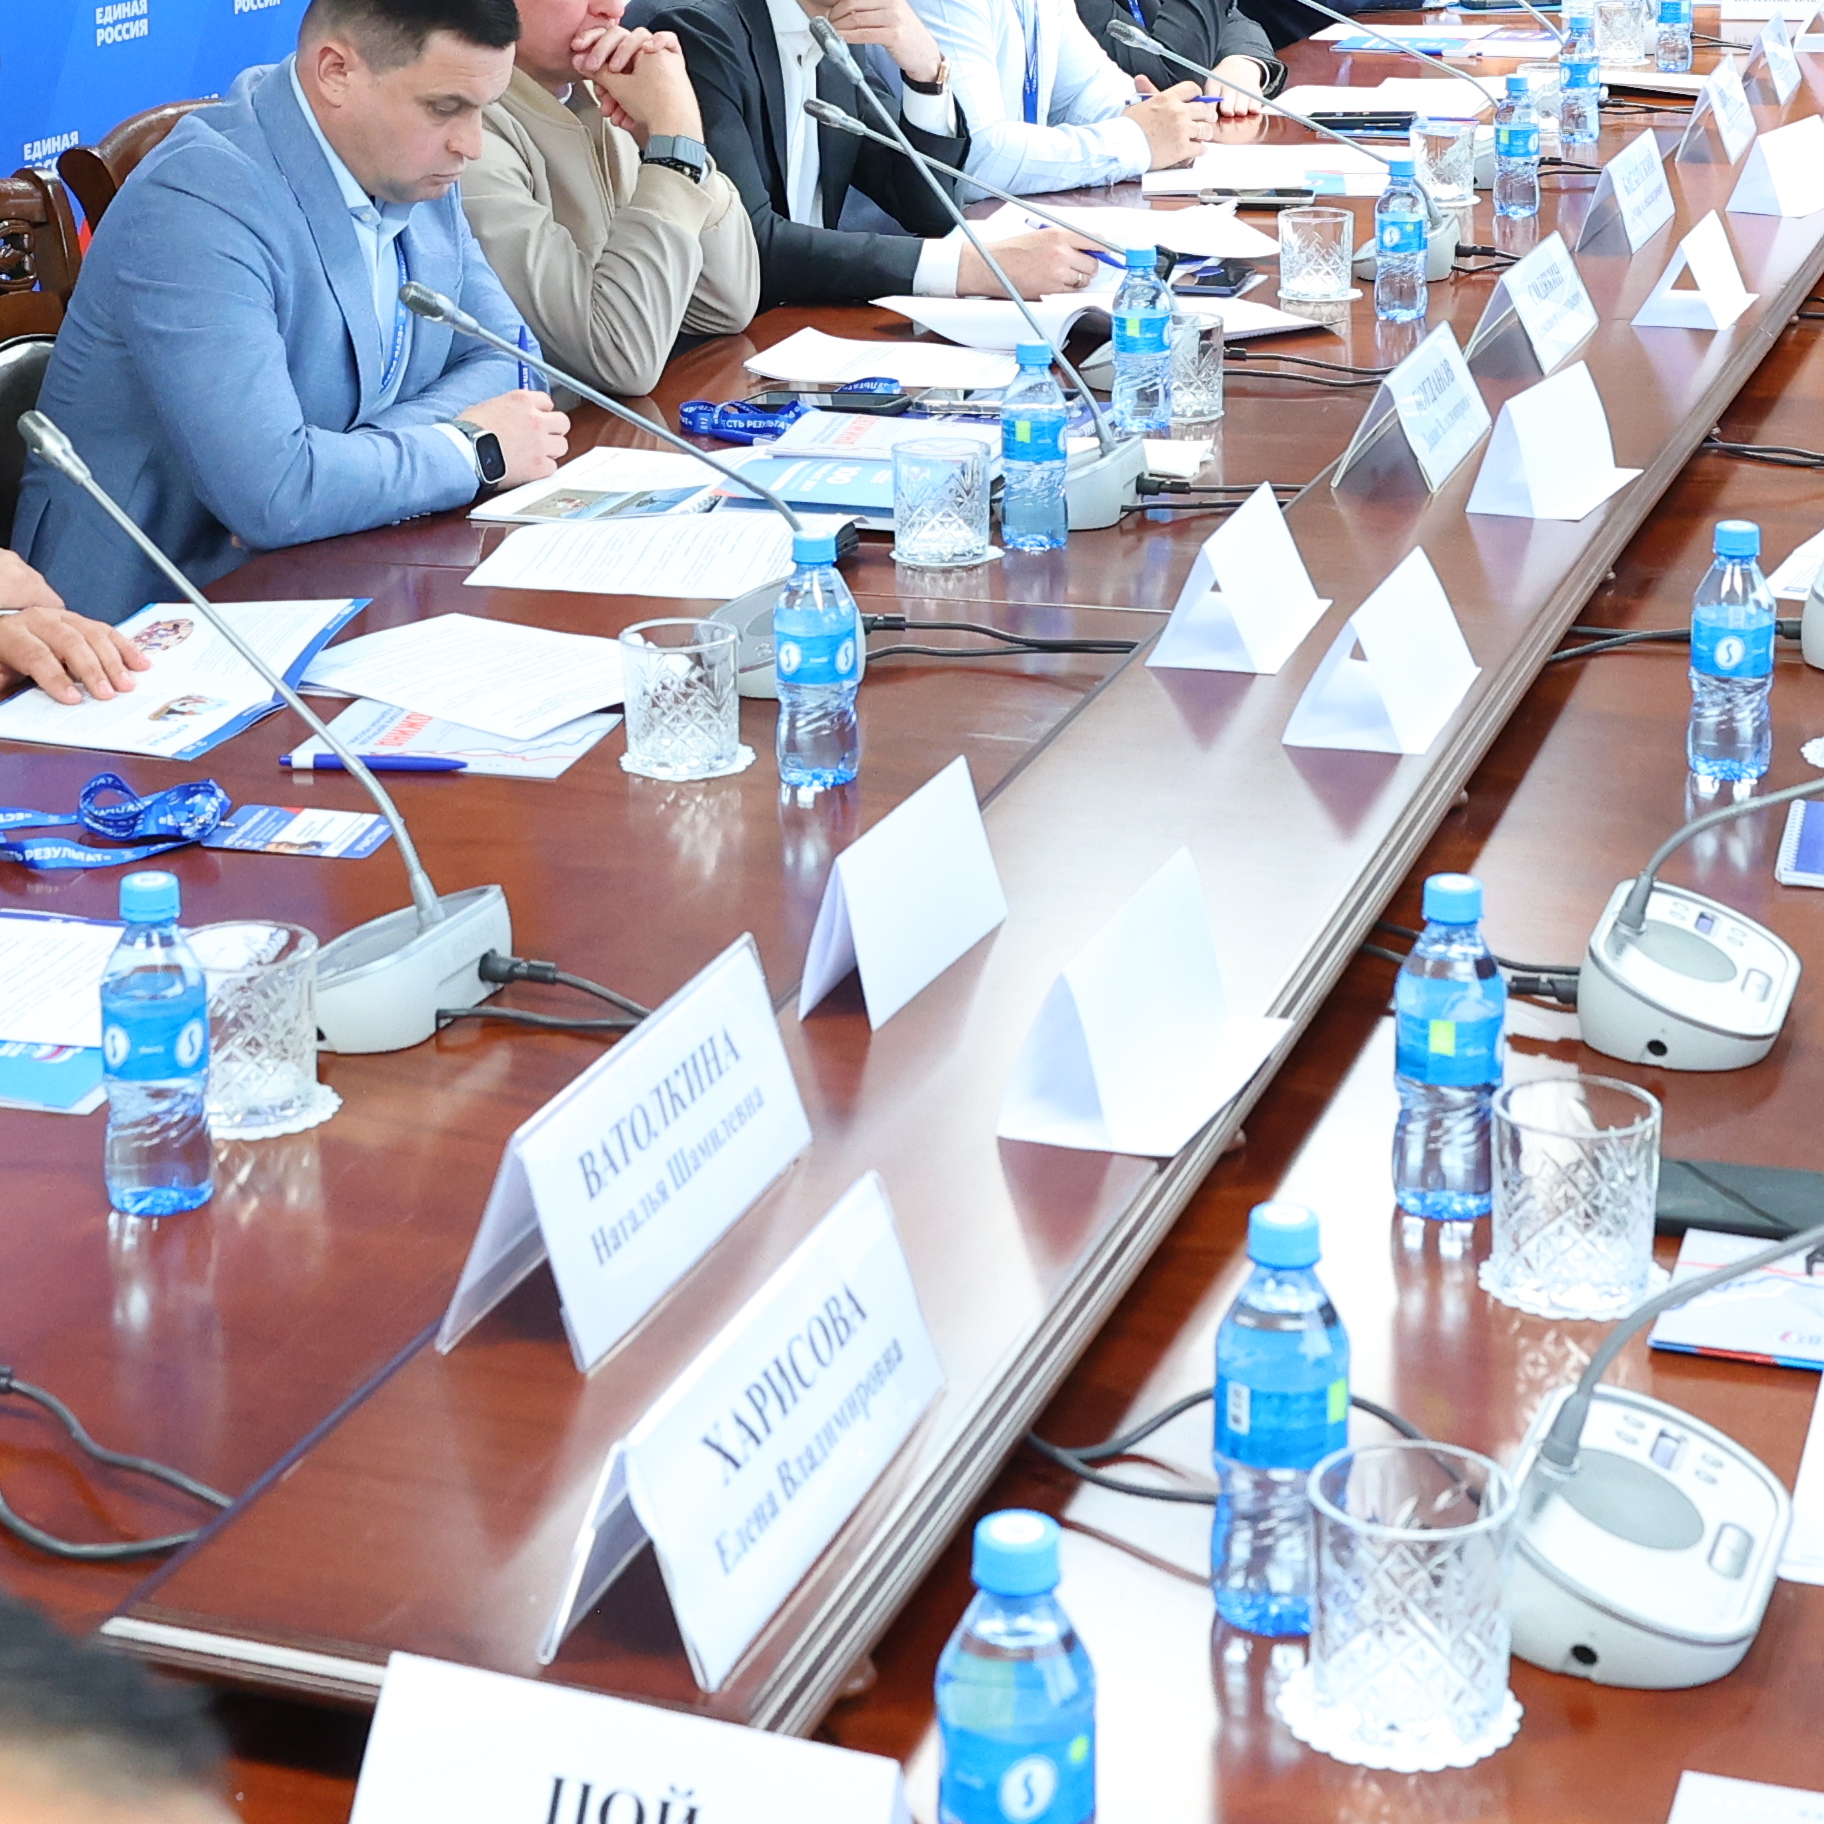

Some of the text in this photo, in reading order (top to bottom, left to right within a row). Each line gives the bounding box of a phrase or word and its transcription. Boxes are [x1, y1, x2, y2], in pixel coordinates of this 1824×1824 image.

[24, 845, 112, 864] РЕЗУЛЬТАТ»
[578, 1025, 741, 1202] ВАТОЛКИНА
[590, 1084, 766, 1267] Наталья Шамилевна
[700, 1280, 868, 1488] ХАРИСОВА
[714, 1336, 905, 1576] Елена Владимировна
